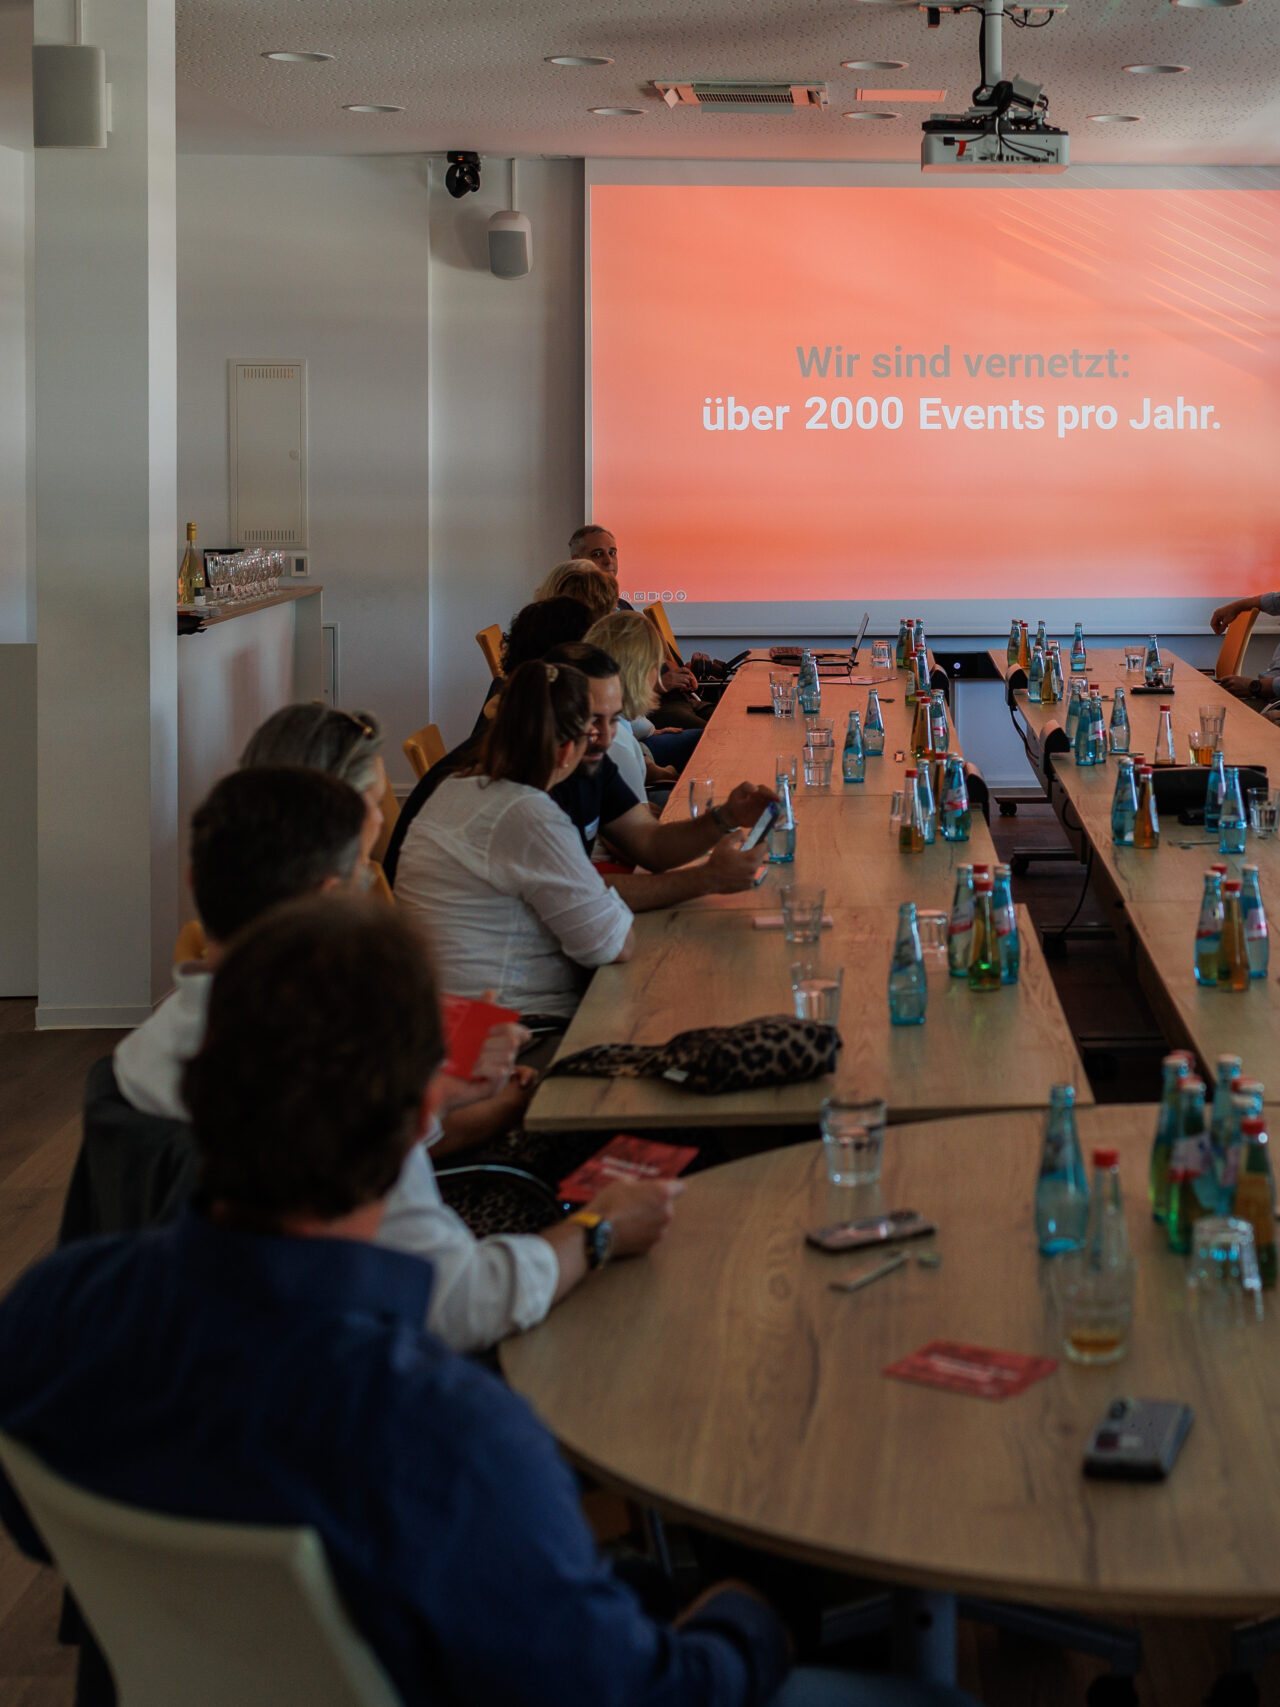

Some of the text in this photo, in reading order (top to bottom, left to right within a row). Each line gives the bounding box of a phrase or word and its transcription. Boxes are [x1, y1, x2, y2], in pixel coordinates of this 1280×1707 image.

[796, 344, 1130, 379] Wir sind vernetzt:
[703, 396, 1221, 439] über 2000 Events pro Jahr.
